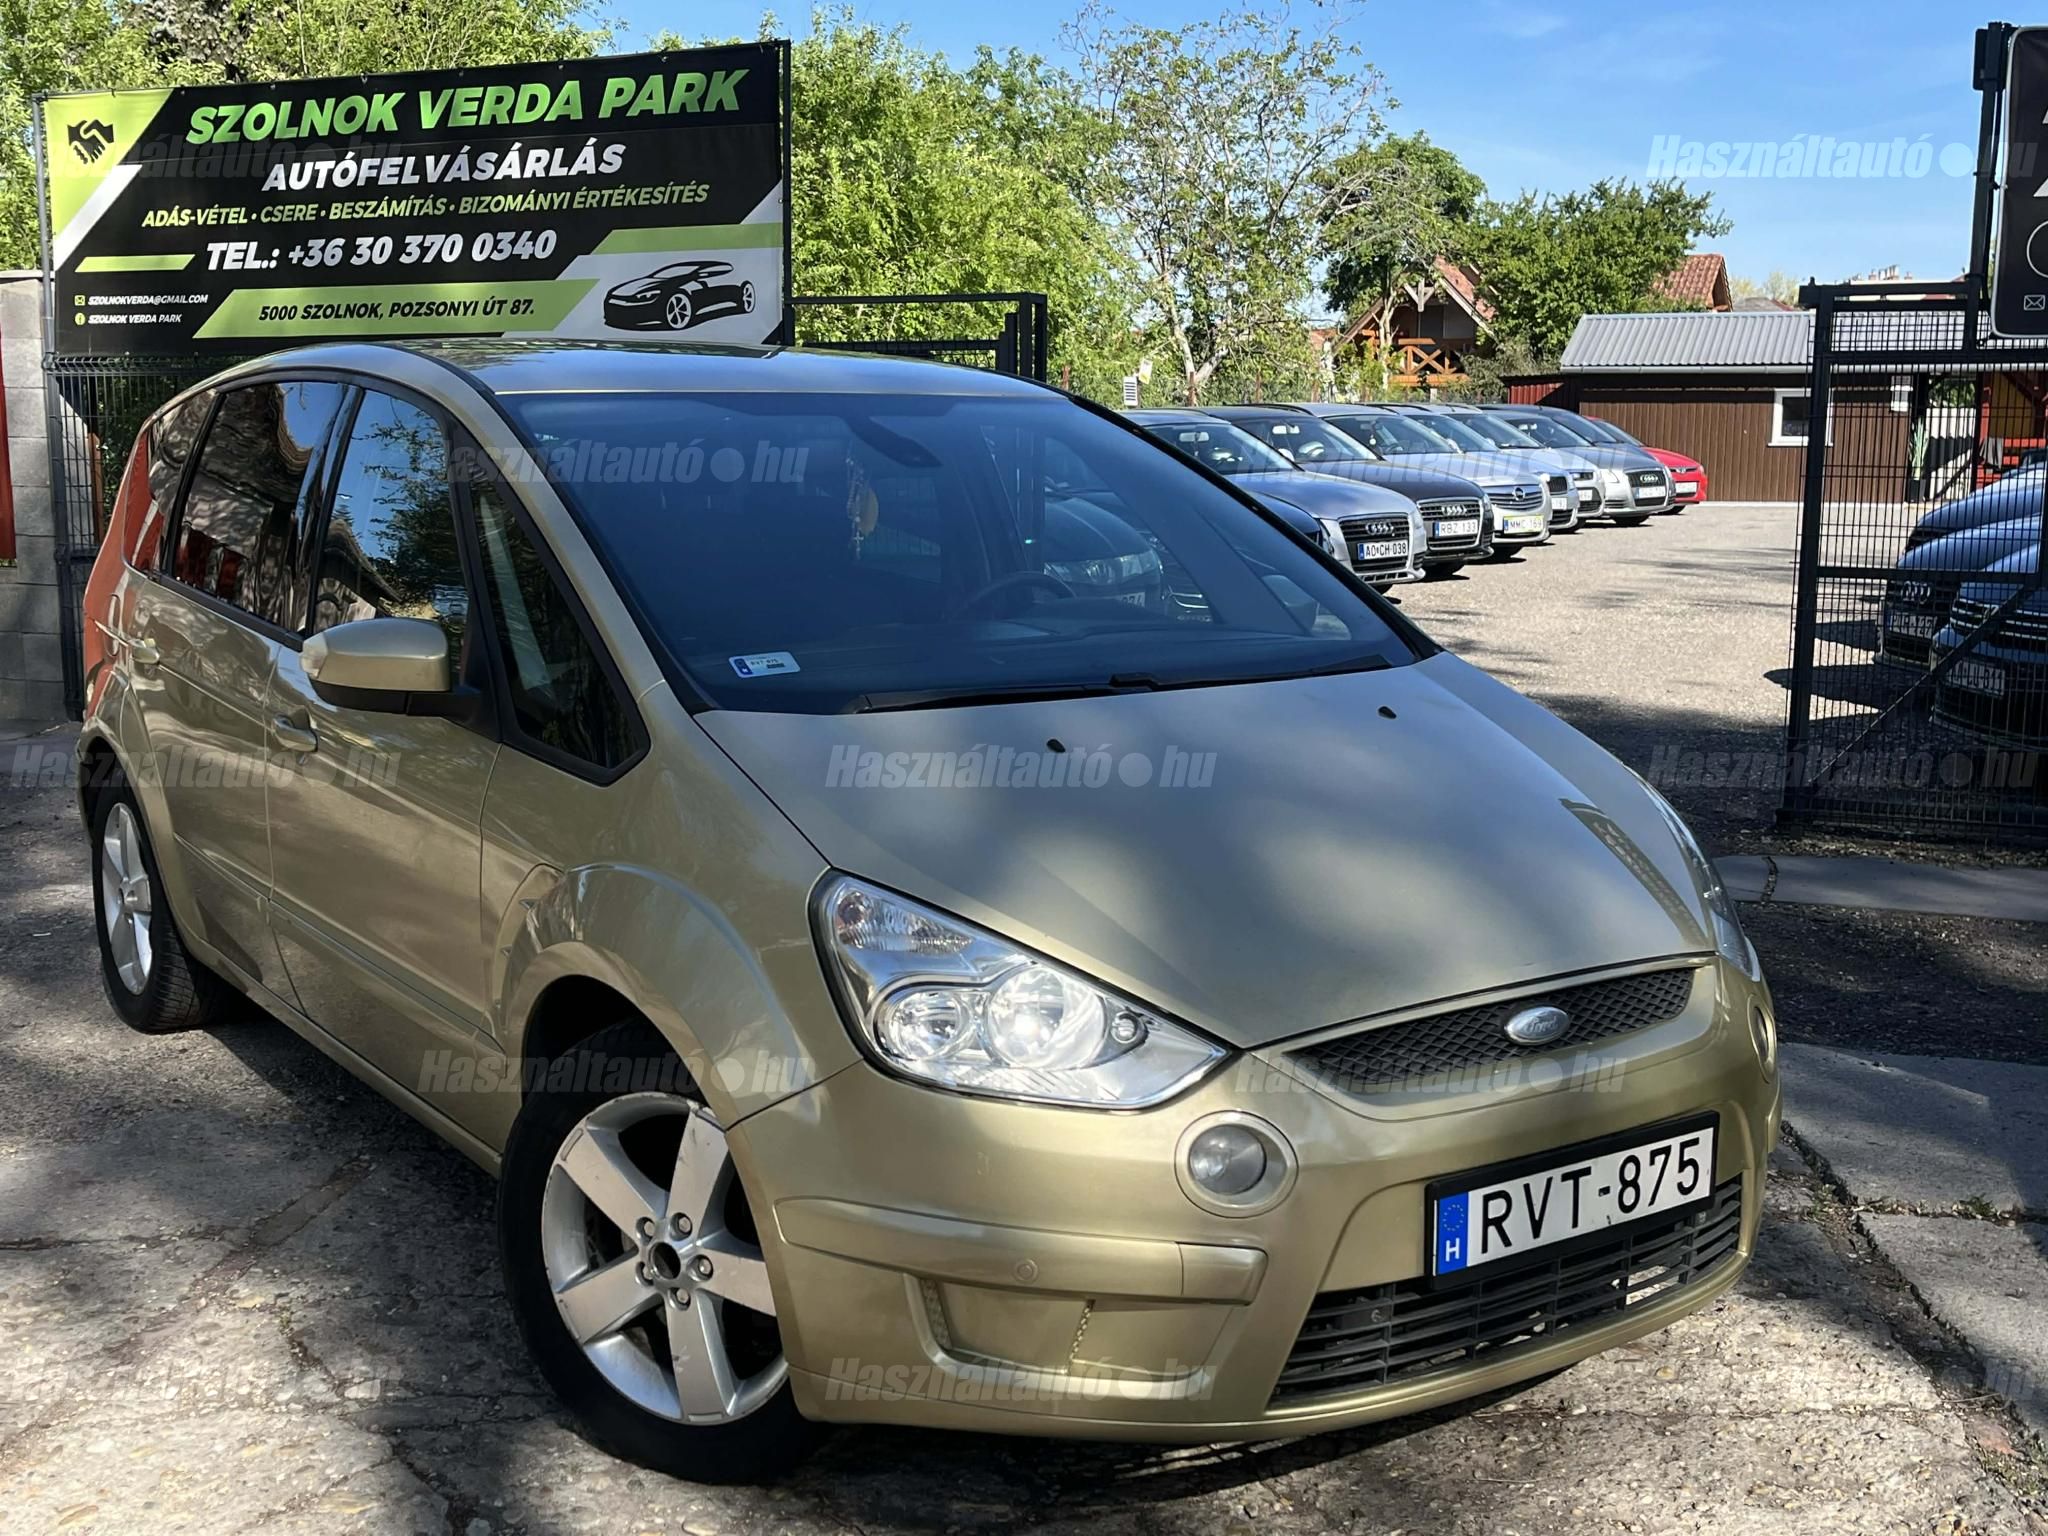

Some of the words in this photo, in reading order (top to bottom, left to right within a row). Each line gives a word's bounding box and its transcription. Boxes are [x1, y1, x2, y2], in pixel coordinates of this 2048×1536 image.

[185, 92, 405, 145] SZOLNOK
[417, 81, 583, 129] VERDA
[598, 69, 751, 119] PARK
[261, 137, 626, 192] AUTÓFELVÁSÁRLÁS
[142, 204, 248, 227] ADÁS-VÉTEL
[260, 204, 318, 223] CSERE
[329, 194, 447, 219] BESZÁMÍTÁS
[458, 189, 570, 214] BIZOMÁNYI
[573, 180, 710, 209] ÉRTÉKESÍTÉS
[206, 241, 280, 271] TEL.:
[288, 238, 346, 267] +36
[350, 236, 393, 265] 30
[399, 233, 463, 264] 370
[471, 229, 557, 262] 0340
[88, 294, 208, 306] SZOLNOKVERDA@GMAIL.COM
[88, 314, 127, 324] SZOLNOK
[129, 314, 157, 324] VERDA
[158, 314, 182, 323] PARK
[259, 305, 297, 321] 5000
[301, 303, 383, 320] SZOLNOK,
[389, 300, 478, 318] POZSONYI
[482, 296, 507, 316] ÚT
[509, 299, 534, 315] 87.
[1481, 1137, 1700, 1254] RVT-875
[1445, 1238, 1461, 1262] H
